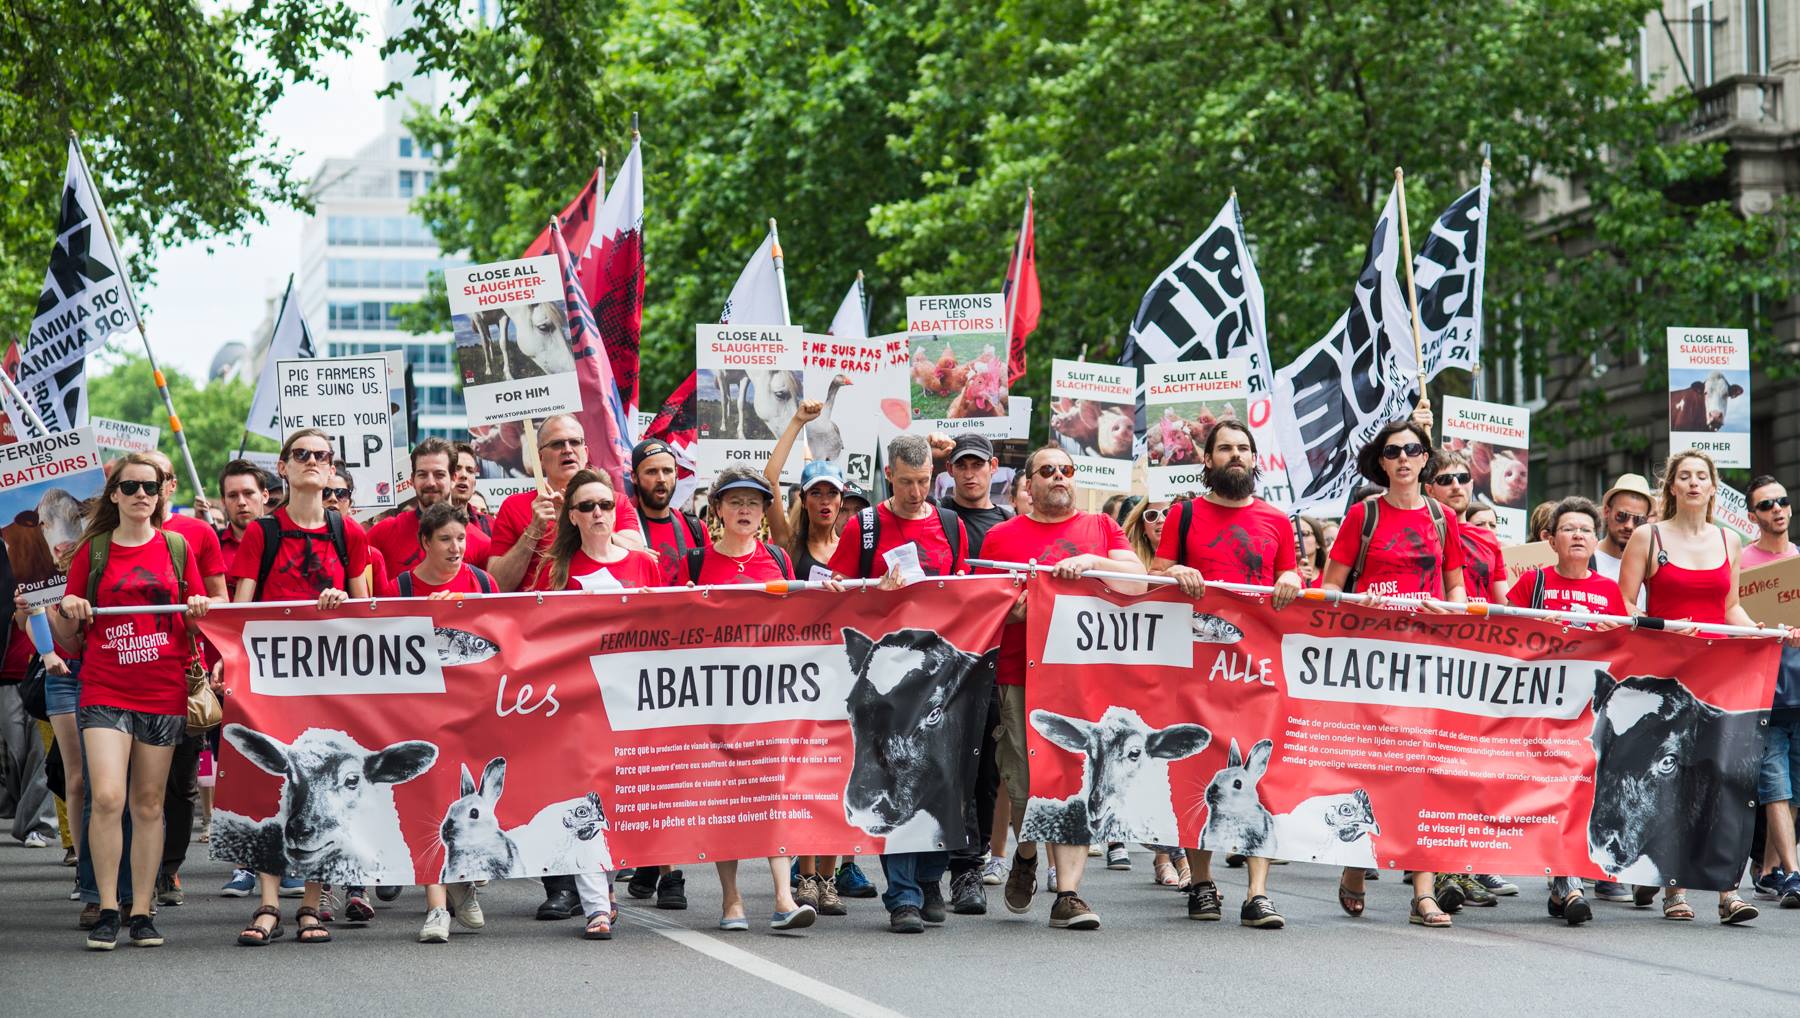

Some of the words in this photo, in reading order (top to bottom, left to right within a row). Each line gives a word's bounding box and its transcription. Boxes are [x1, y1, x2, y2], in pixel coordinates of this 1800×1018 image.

[468, 269, 510, 282] CLOSE
[514, 265, 538, 276] ALL
[464, 276, 545, 295] SLAUGHTER-
[479, 289, 535, 305] HOUSES!
[920, 297, 992, 310] FERMONS
[946, 310, 966, 318] LES
[911, 318, 993, 332] ABATTOIRS
[717, 332, 756, 340] CLOSE
[760, 332, 782, 341] ALL
[1684, 334, 1713, 343] CLOSE
[712, 343, 788, 353] SLAUGHTER-
[812, 342, 827, 355] NE
[832, 344, 856, 357] SUIS
[860, 348, 881, 360] PAS
[886, 342, 900, 352] NE
[1680, 345, 1738, 354] SLAUGHTER-
[724, 355, 776, 365] HOUSES!
[812, 356, 836, 368] FOIE
[841, 360, 871, 373] GRAS
[1690, 356, 1729, 364] HOUSES!
[289, 369, 308, 381] PIG
[317, 367, 375, 380] FARMERS
[1068, 371, 1095, 381] SLUIT
[1098, 375, 1121, 384] ALLE
[1164, 373, 1196, 383] SLUIT
[1200, 371, 1228, 380] ALLE
[284, 385, 309, 397] ARE
[318, 384, 354, 396] SUING
[363, 382, 382, 394] US.
[496, 391, 522, 403] FOR
[526, 386, 550, 399] HIM
[1056, 380, 1132, 395] SLACHTHUIZEN!
[1151, 380, 1242, 394] SLACHTHUIZEN!
[284, 416, 304, 427] WE
[313, 414, 345, 427] NEED
[354, 413, 386, 424] YOUR
[485, 405, 565, 420] WWW.STOPABATTOIRS.ORG
[1459, 410, 1487, 421] SLUIT
[1489, 415, 1513, 426] ALLE
[100, 421, 150, 436] FERMONS
[1447, 418, 1524, 438] SLACHTHUIZEN!
[328, 435, 383, 468] LP
[1692, 442, 1710, 450] FOR
[1713, 443, 1730, 451] HER
[30, 453, 52, 466] LES
[726, 450, 751, 459] FOR
[1096, 466, 1115, 475] HEN
[1169, 474, 1202, 484] VOOR
[490, 488, 519, 496] VOOR
[1723, 501, 1738, 513] LES
[863, 532, 873, 549] SEA
[18, 580, 45, 592] Pour
[48, 575, 67, 586] elle
[1562, 590, 1570, 600] LA
[106, 623, 134, 640] CLOSE
[600, 623, 832, 650] FERMONS-LES-ABATTOIRS.ORG
[1076, 610, 1163, 651] SLUIT
[1310, 609, 1582, 654] STOPABATTOIRS.ORG
[117, 632, 170, 651] SLAUGHTER
[119, 648, 159, 664] HOUSES
[251, 634, 427, 679] FERMONS
[1208, 650, 1275, 686] ALLE
[1299, 646, 1567, 706] SLACHTHUIZEN!
[637, 662, 820, 711] ABATTOIRS
[495, 674, 560, 717] les
[1288, 716, 1309, 726] Omdat
[1323, 721, 1360, 730] productie
[1379, 724, 1398, 732] vlees
[1400, 726, 1438, 736] impliceert
[1439, 729, 1448, 737] dat
[1458, 732, 1478, 742] dieren
[1480, 734, 1490, 743] die
[1510, 736, 1521, 744] eet
[1286, 730, 1307, 739] omdat
[1310, 732, 1330, 740] velen
[1374, 736, 1396, 746] lijden
[1398, 738, 1421, 747] onder
[1423, 740, 1436, 748] hun
[615, 747, 636, 756] Parce
[638, 746, 650, 756] que
[1284, 743, 1307, 752] omdat
[1320, 747, 1366, 757] consumptie
[1384, 750, 1403, 759] vlees
[1427, 754, 1458, 764] noodzaak
[616, 766, 636, 775] Parce
[638, 765, 650, 775] que
[752, 756, 780, 765] conditions
[1283, 755, 1306, 764] omdat
[1309, 759, 1345, 769] gevoelige
[1378, 763, 1393, 771] niet
[1395, 765, 1425, 773] moeten
[1427, 767, 1468, 776] mishandeld
[1507, 773, 1530, 781] zonder
[616, 785, 635, 794] Parce
[638, 784, 650, 794] que
[656, 781, 693, 790] consommation
[738, 778, 747, 786] pas
[616, 804, 635, 812] Parce
[637, 803, 649, 812] que
[615, 821, 650, 831] l'élevage,
[653, 818, 659, 828] la
[662, 816, 685, 829] pêche
[688, 816, 696, 825] et
[698, 815, 705, 825] la
[708, 814, 735, 824] chasse
[738, 811, 767, 822] doivent
[770, 808, 786, 819] être
[788, 808, 813, 819] abolis.
[1419, 809, 1455, 820] daarom
[1458, 812, 1496, 822] moeten
[1499, 814, 1511, 823] de
[1514, 814, 1559, 825] veeteelt,
[1418, 823, 1430, 832] de
[1432, 824, 1465, 836] visserij
[1483, 826, 1494, 835] de
[1496, 827, 1523, 838] jacht
[1417, 836, 1468, 848] afgeschaft
[1470, 840, 1512, 850] worden.
